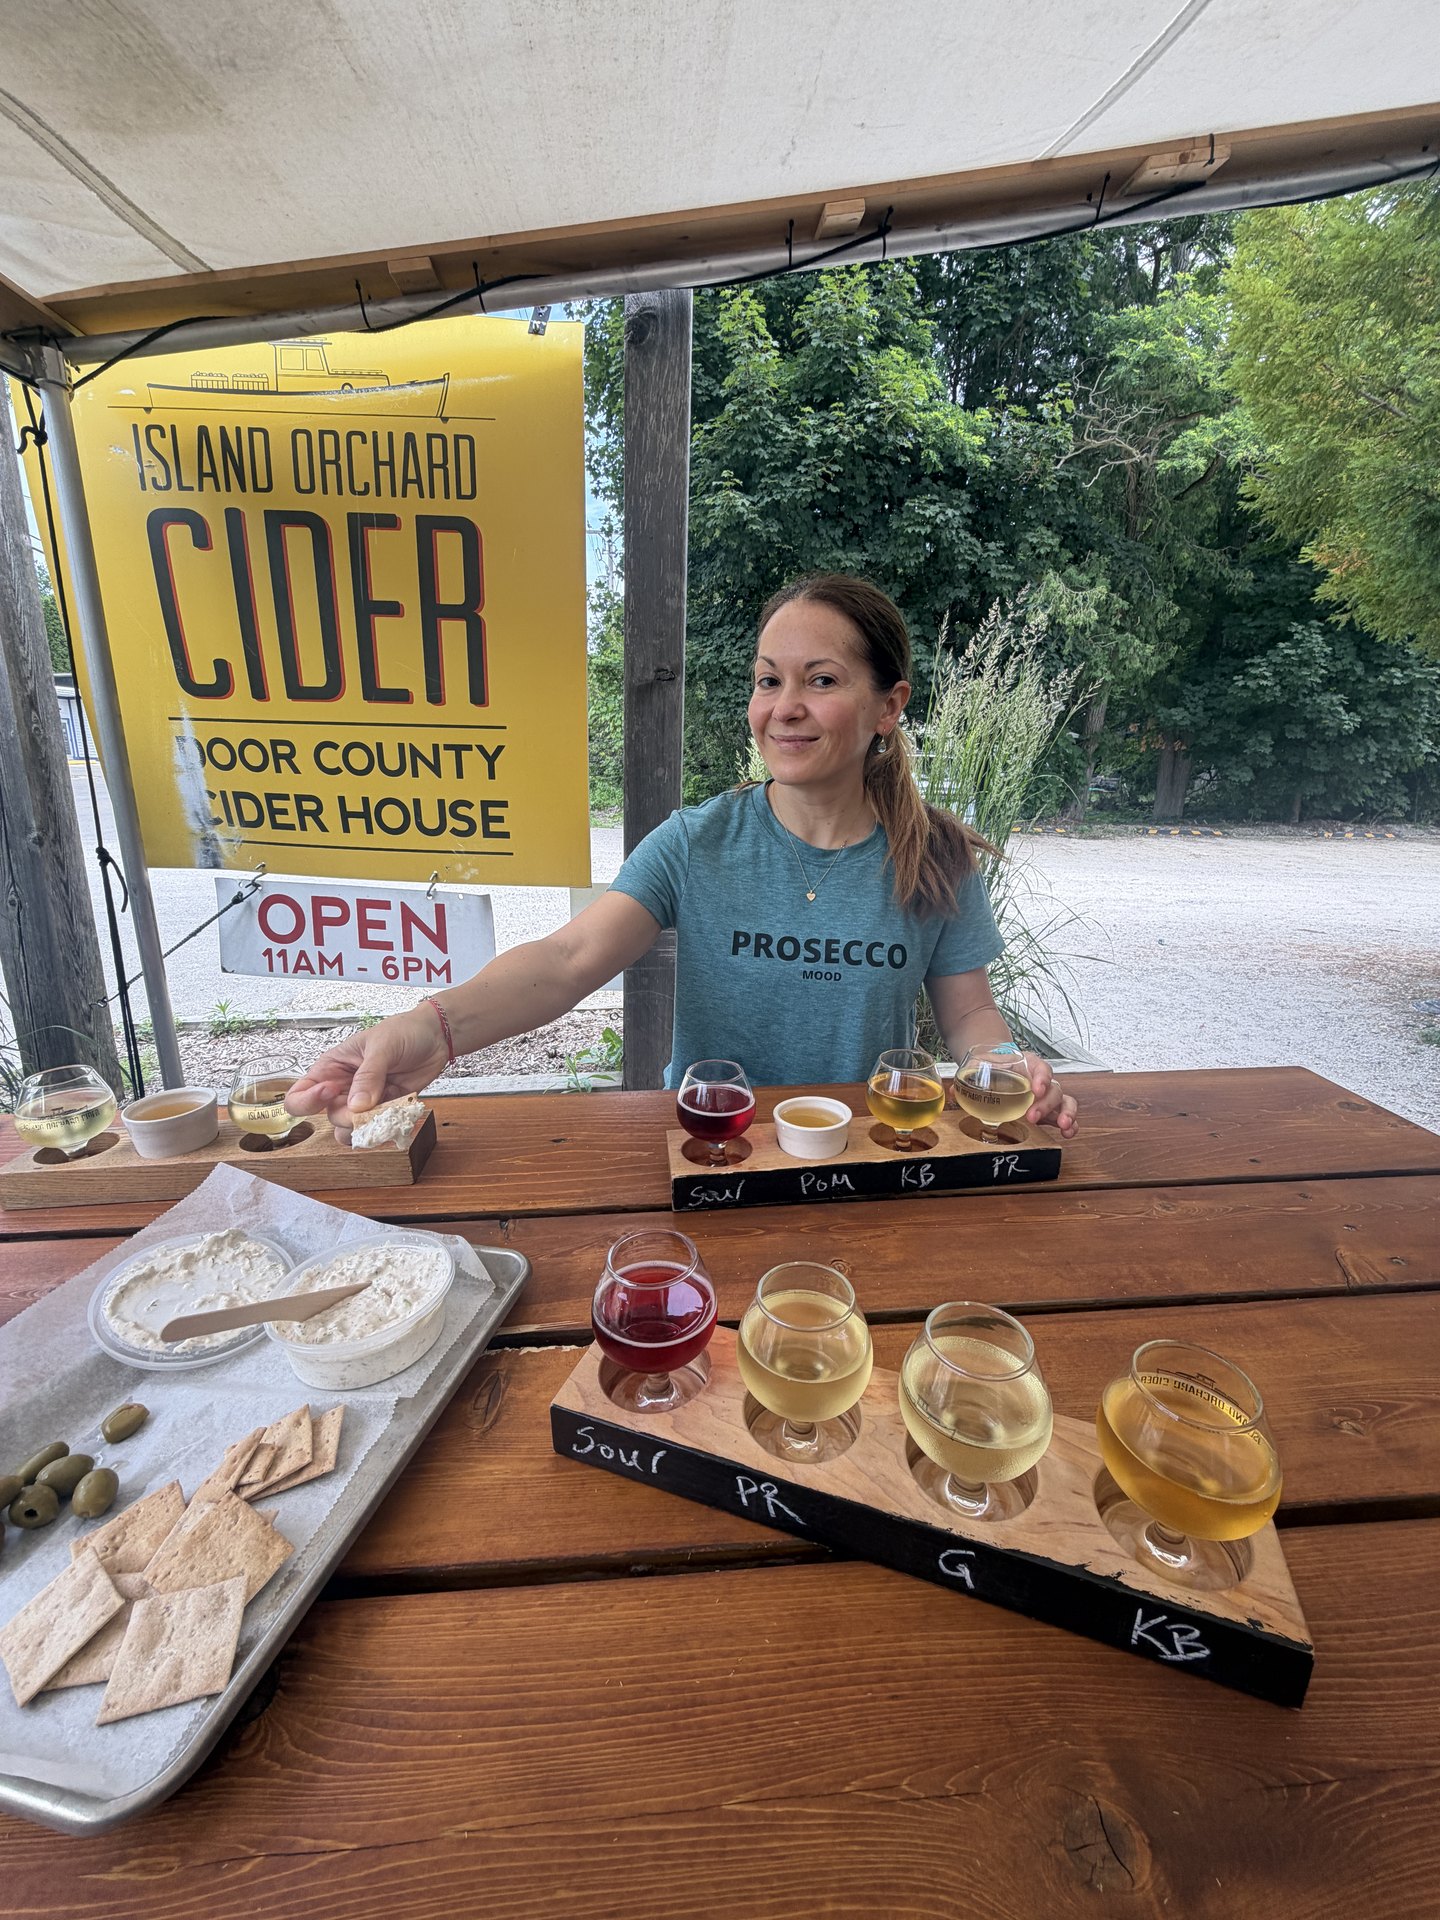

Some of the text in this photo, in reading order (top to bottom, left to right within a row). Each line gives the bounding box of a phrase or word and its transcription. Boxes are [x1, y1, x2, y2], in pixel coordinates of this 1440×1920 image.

[131, 423, 478, 500] ISLAND ORCHARD
[146, 507, 489, 707] CIDER
[313, 740, 506, 781] COUNTY
[337, 795, 511, 839] HOUSE
[257, 893, 449, 955] OPEN
[261, 947, 344, 977] 11AM
[381, 955, 452, 984] 6PM
[731, 930, 908, 970] PROSECCO
[802, 970, 842, 982] MOOD
[901, 1163, 936, 1188] KB
[992, 1155, 1031, 1178] PR
[572, 1425, 668, 1475] Sour
[735, 1475, 809, 1526] PR
[1130, 1607, 1211, 1661] KB
